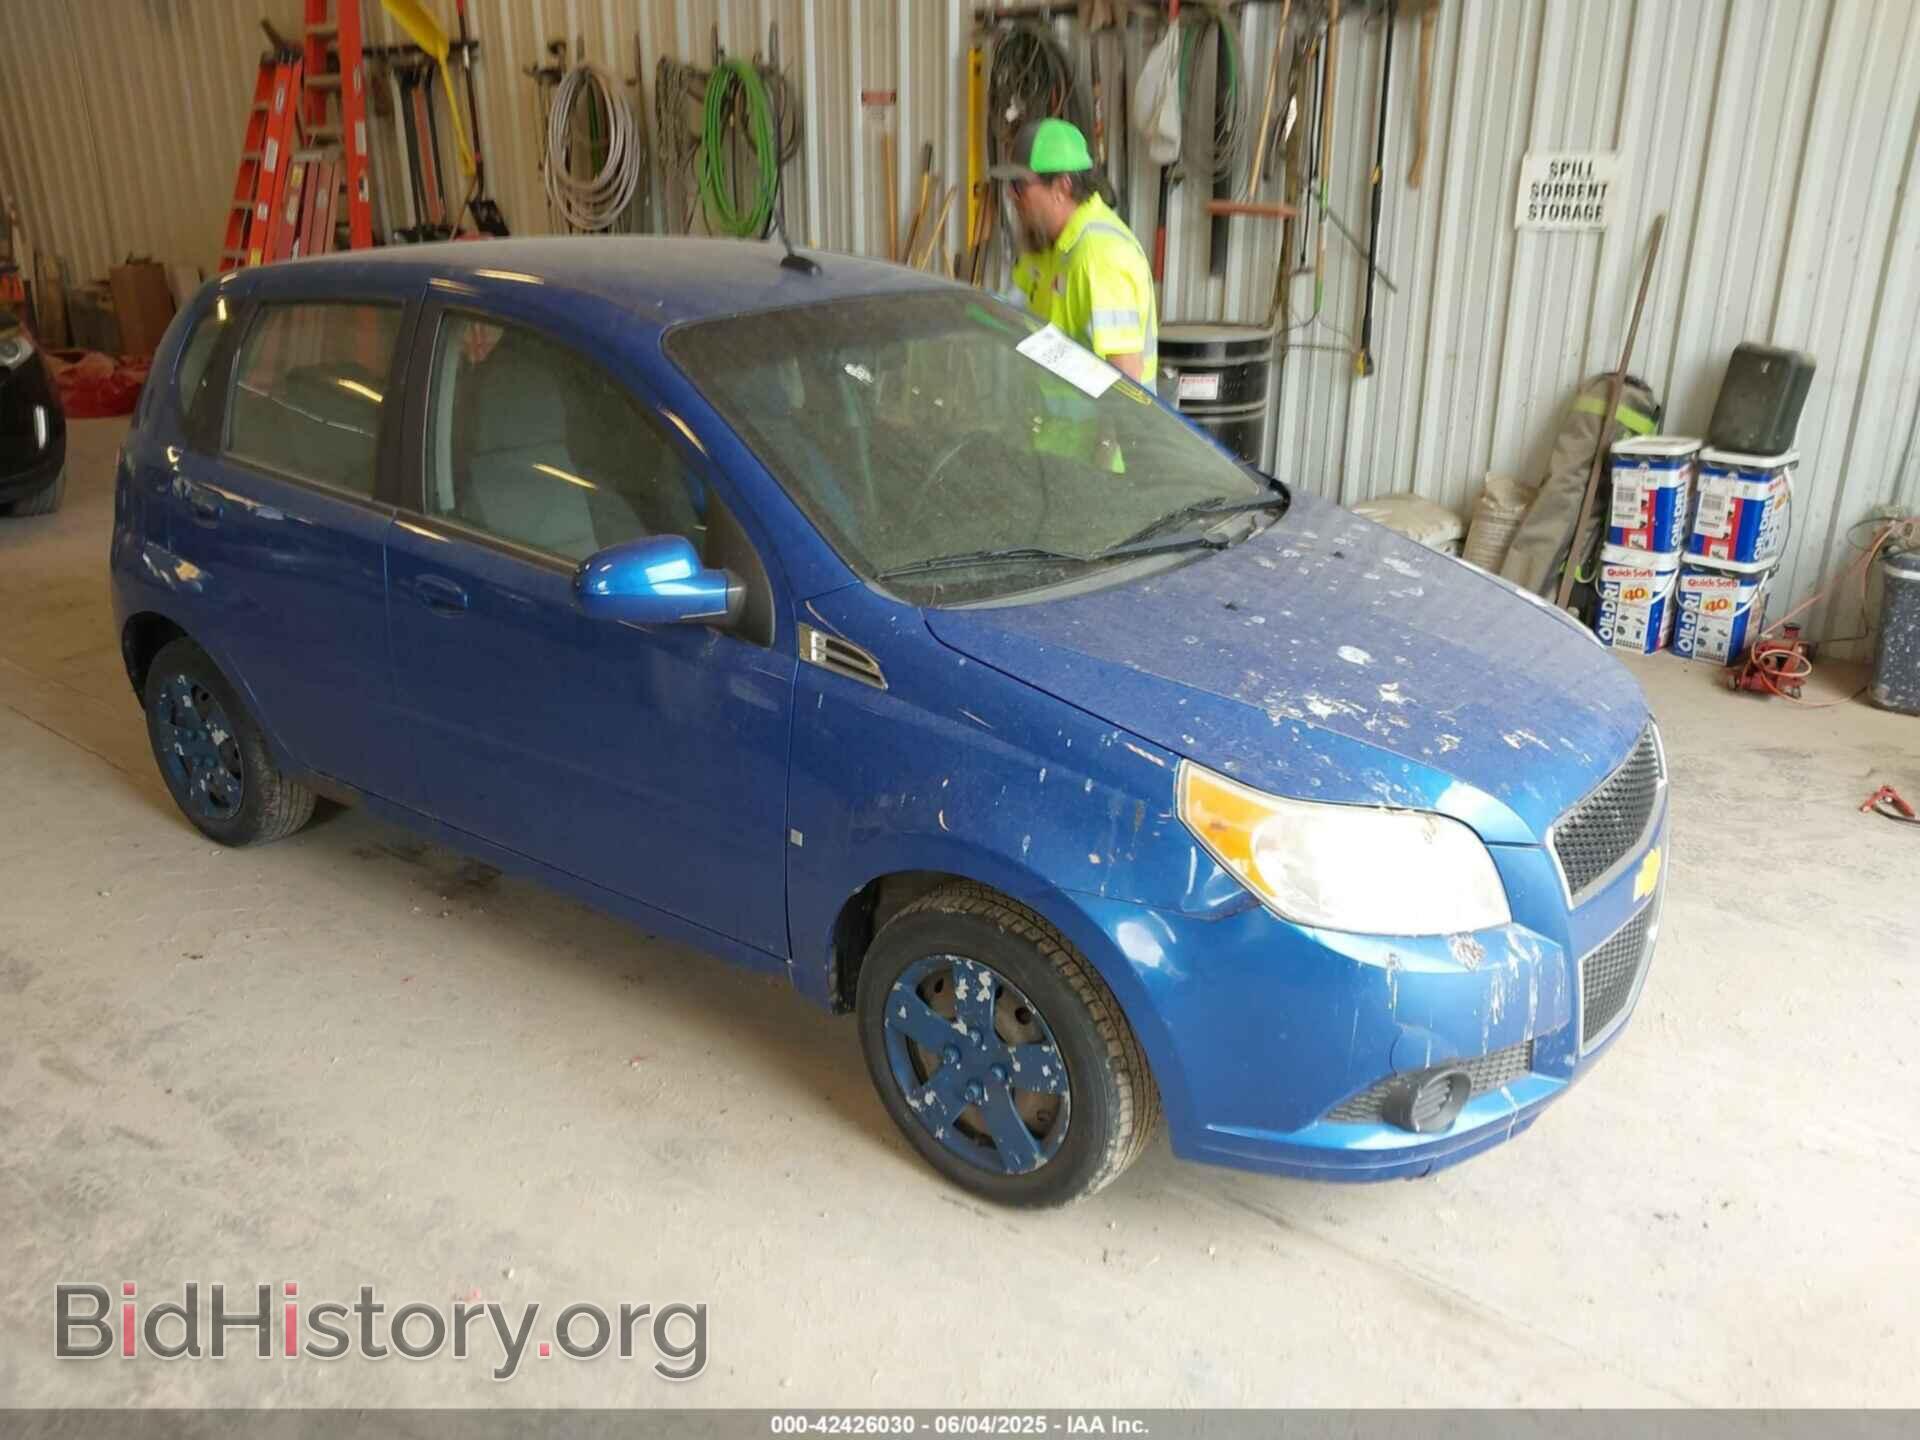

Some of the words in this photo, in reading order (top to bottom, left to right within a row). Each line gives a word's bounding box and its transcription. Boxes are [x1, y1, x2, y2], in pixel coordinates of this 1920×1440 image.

[1549, 161, 1595, 178] SPILL
[1529, 182, 1607, 200] SORBENT
[1528, 202, 1603, 221] STORAGE
[1624, 587, 1646, 601] 40
[1704, 598, 1729, 612] 40
